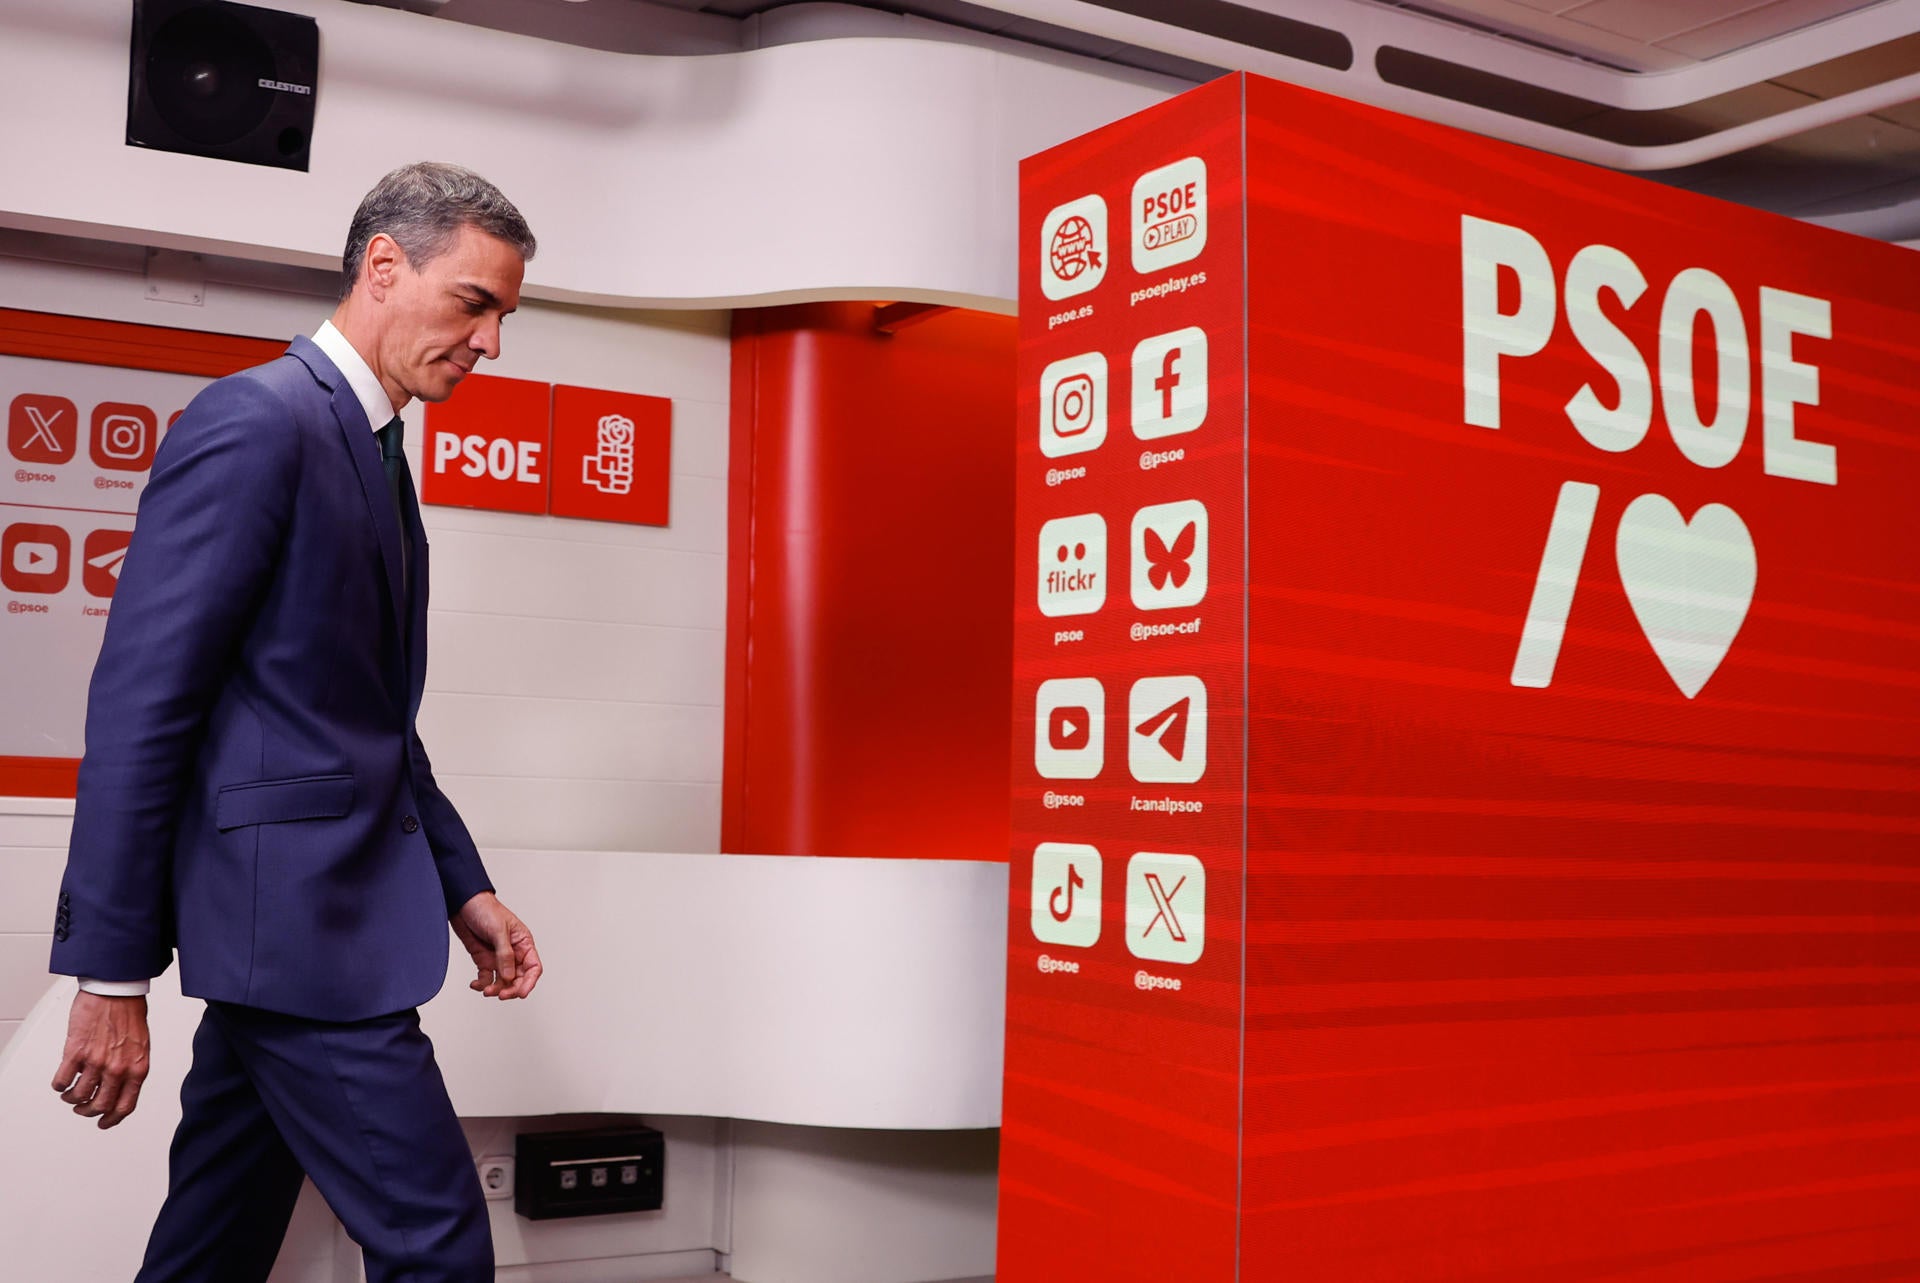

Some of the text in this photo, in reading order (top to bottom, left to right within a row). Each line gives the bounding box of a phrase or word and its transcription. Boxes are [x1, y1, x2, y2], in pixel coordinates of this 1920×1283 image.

[1143, 182, 1197, 223] PSOE
[1163, 218, 1190, 242] PLAY
[1130, 271, 1207, 306] psoeplay.es
[1048, 305, 1094, 330] psoe.es
[1461, 214, 1838, 485] PSOE
[434, 431, 542, 484] PSOE
[1139, 448, 1185, 470] @psoe
[15, 469, 56, 483] @psoe
[94, 476, 134, 490] @psoe
[1045, 466, 1087, 487] @psoe
[1046, 568, 1097, 594] flickr
[8, 600, 49, 614] @psoe
[82, 604, 110, 617] /can
[1054, 630, 1085, 646] psoe
[1130, 617, 1201, 642] @psoe-cef
[1043, 790, 1085, 809] @psoe
[1130, 795, 1203, 815] /canalpsoe
[1037, 953, 1080, 974] @psoe
[1134, 969, 1182, 992] @psoe
